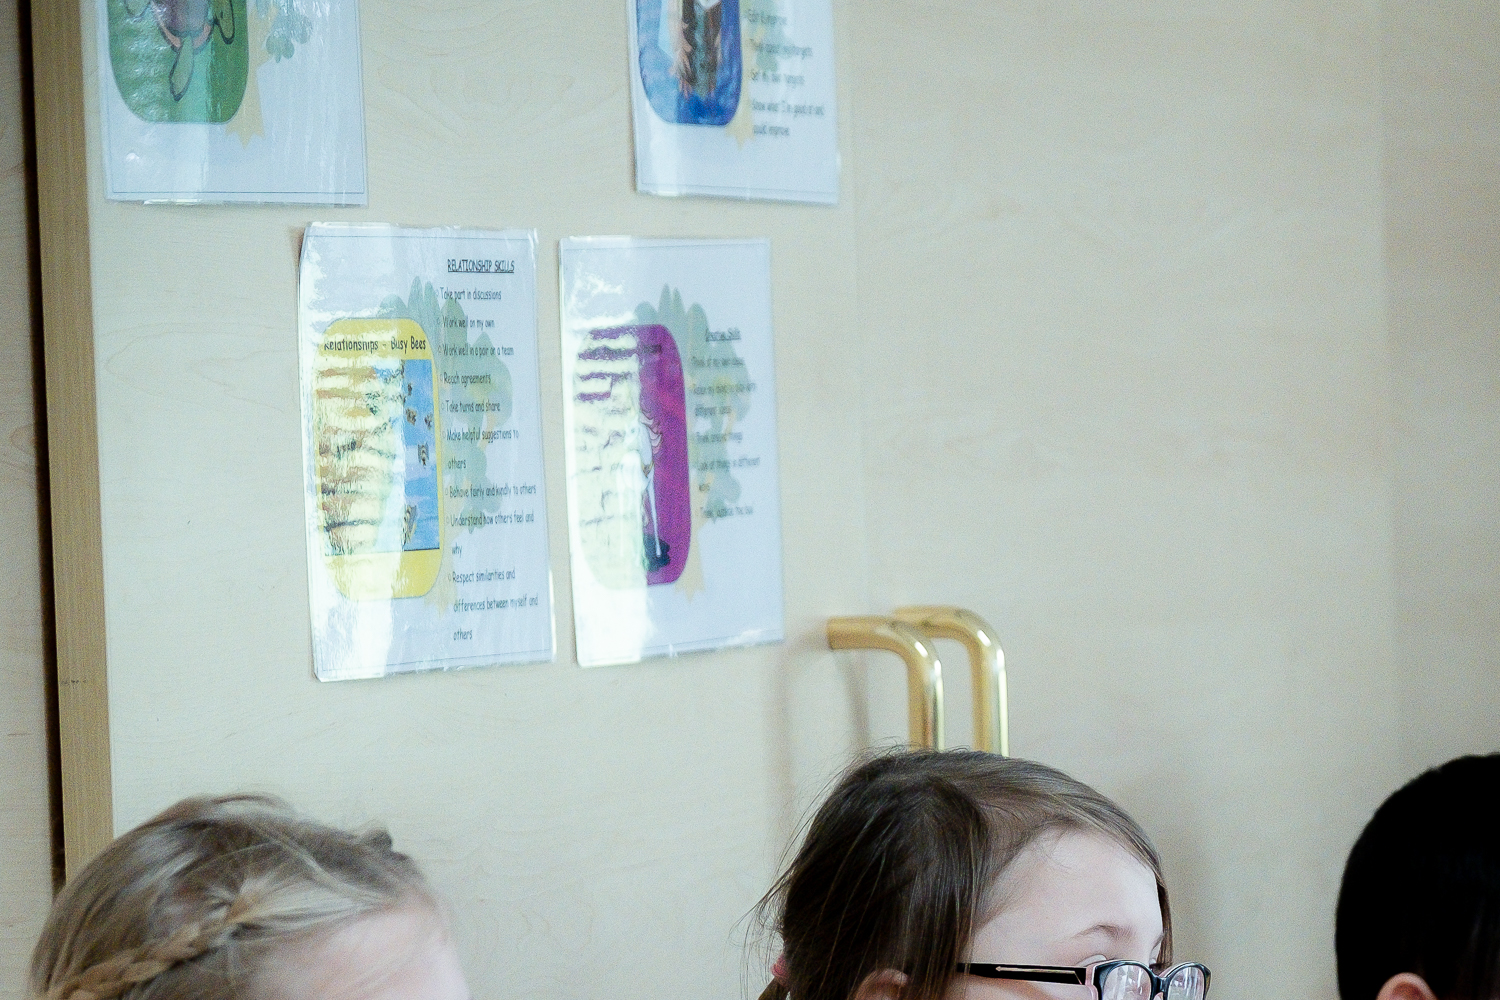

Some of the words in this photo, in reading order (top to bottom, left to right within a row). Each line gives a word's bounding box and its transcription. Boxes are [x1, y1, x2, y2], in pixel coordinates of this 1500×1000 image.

[448, 259, 492, 273] RELATIONSHIP
[494, 260, 515, 273] SKILLS
[440, 287, 453, 300] Take
[454, 288, 466, 303] part
[466, 288, 472, 300] in
[472, 287, 502, 300] discussions
[442, 315, 457, 328] Work
[458, 315, 468, 328] well
[469, 319, 476, 328] on
[477, 319, 484, 331] my
[485, 319, 495, 328] own
[390, 337, 408, 353] Busy
[410, 336, 427, 350] Bees
[443, 344, 458, 356] Work
[458, 344, 469, 356] well
[501, 345, 515, 356] team
[443, 371, 460, 384] Reach
[461, 373, 492, 387] agreements
[446, 400, 458, 412] Take
[460, 401, 474, 413] turns
[475, 400, 485, 412] and
[485, 400, 500, 412] share
[446, 429, 461, 441] Make
[461, 427, 480, 444] helpful
[482, 429, 512, 443] suggestions
[513, 429, 519, 439] to
[448, 458, 466, 470] others
[449, 485, 468, 498] Behave
[469, 484, 484, 500] fairly
[485, 484, 495, 497] and
[495, 482, 511, 498] kindly
[513, 484, 519, 495] to
[520, 482, 537, 495] others
[450, 514, 482, 527] Understand
[494, 511, 513, 525] others
[513, 509, 524, 523] feel
[525, 510, 534, 523] and
[452, 542, 462, 557] why
[452, 570, 475, 586] Respect
[476, 567, 505, 582] similarities
[506, 566, 516, 580] and
[453, 598, 485, 613] differences
[486, 596, 509, 610] between
[509, 593, 527, 610] myself
[528, 592, 539, 606] and
[453, 628, 473, 641] others
